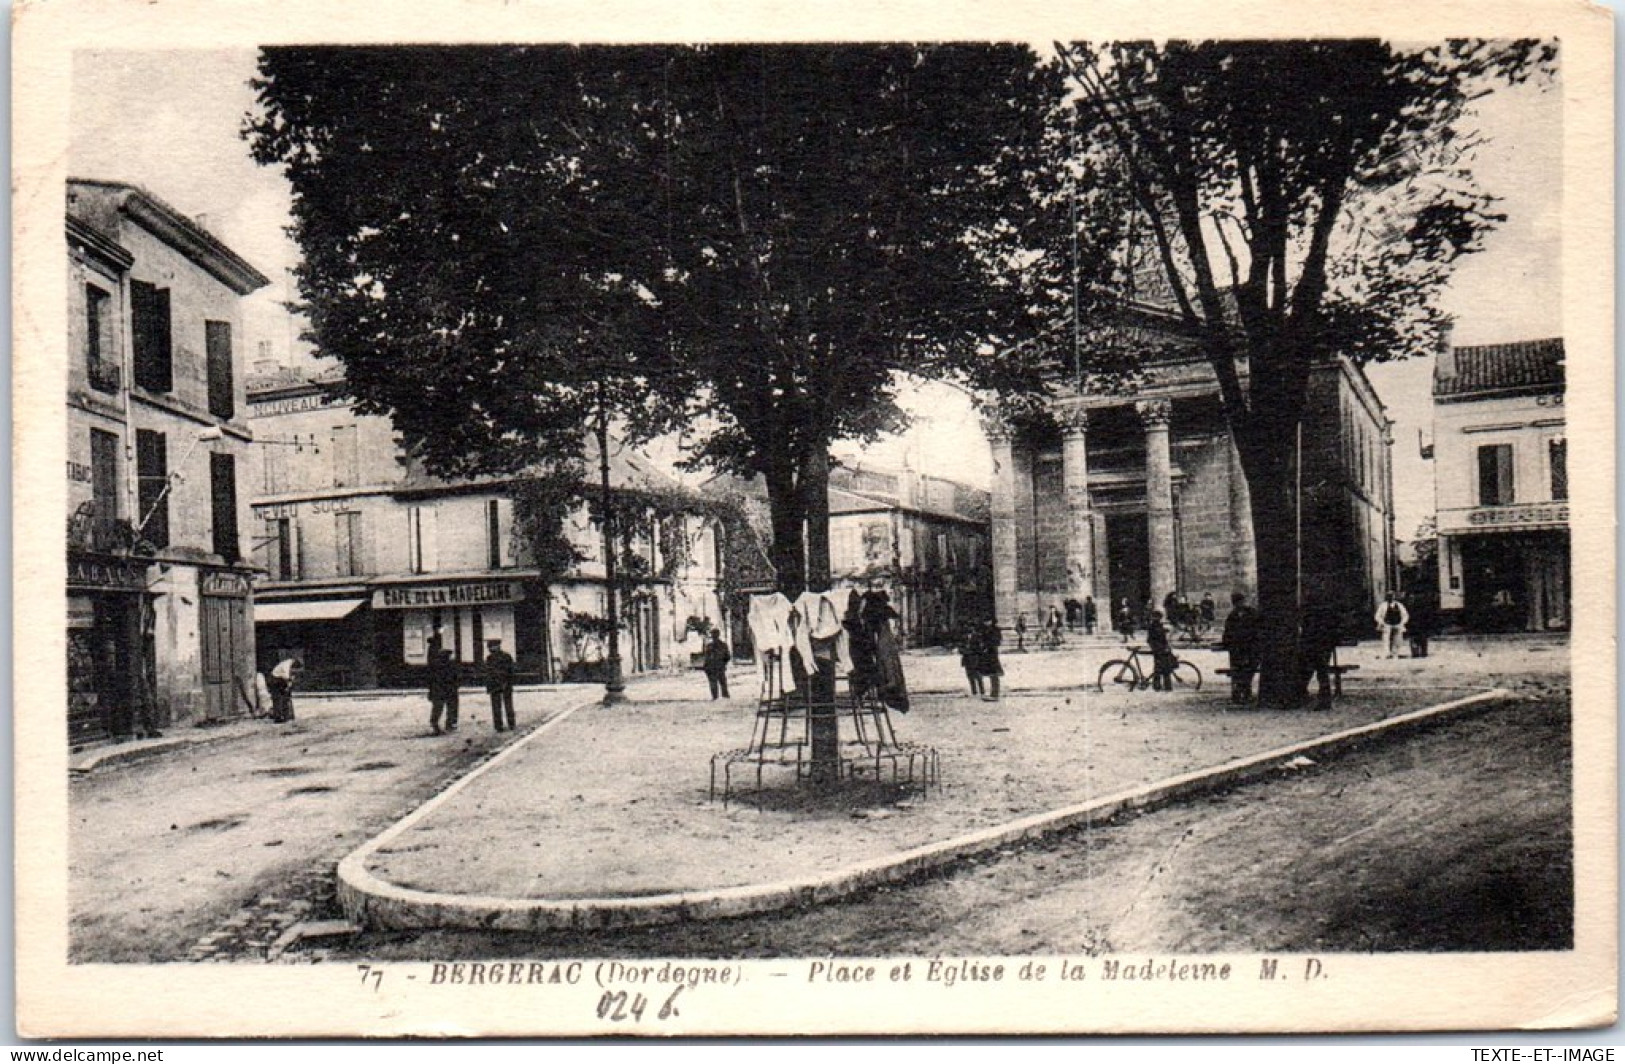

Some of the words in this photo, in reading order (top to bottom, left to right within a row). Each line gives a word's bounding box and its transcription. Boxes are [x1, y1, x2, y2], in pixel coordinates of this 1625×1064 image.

[432, 588, 446, 603] LA
[356, 964, 382, 992] 77
[430, 962, 582, 986] BERGERAC
[807, 958, 877, 984] Place
[889, 963, 912, 983] et
[926, 957, 1005, 988] Église
[1018, 961, 1047, 982] de
[1059, 960, 1087, 982] la
[1102, 958, 1232, 981] Madeleine
